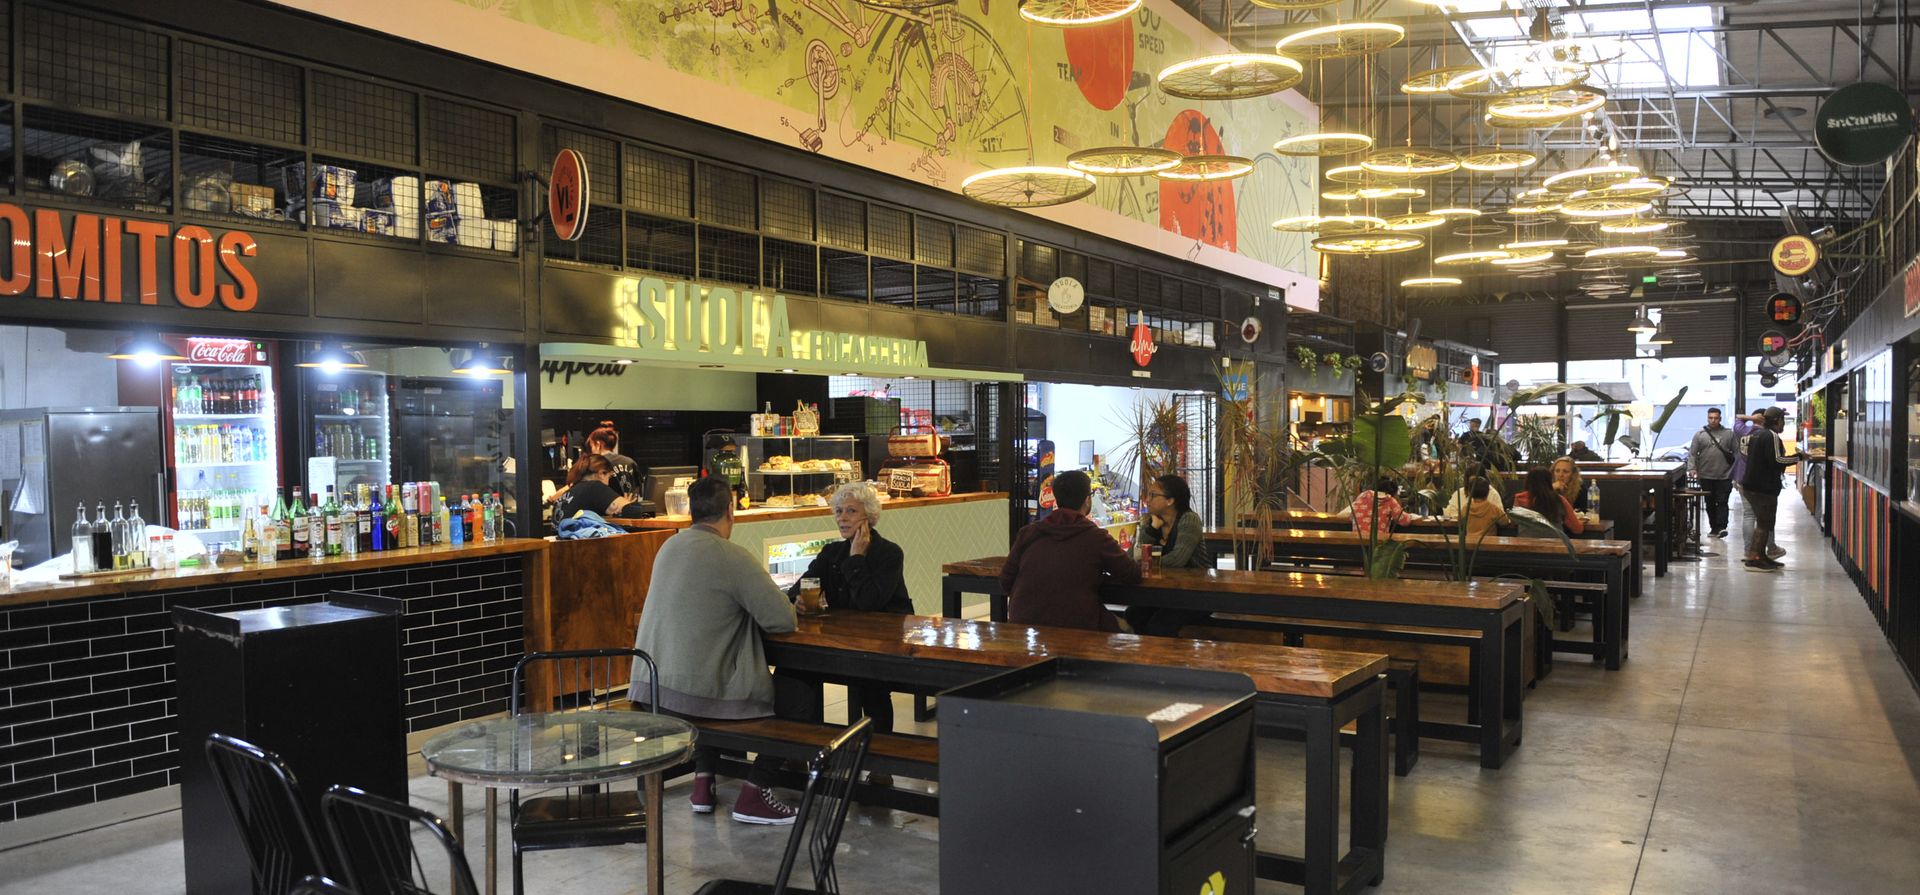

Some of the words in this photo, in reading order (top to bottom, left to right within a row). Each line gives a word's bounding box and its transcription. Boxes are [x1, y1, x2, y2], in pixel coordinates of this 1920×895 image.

[1139, 33, 1165, 54] SPEED
[780, 116, 790, 128] 56
[1110, 121, 1120, 139] IN
[637, 277, 792, 359] SUOLA
[809, 330, 930, 369] FOCACCERIA
[190, 342, 248, 363] Coca-Cola
